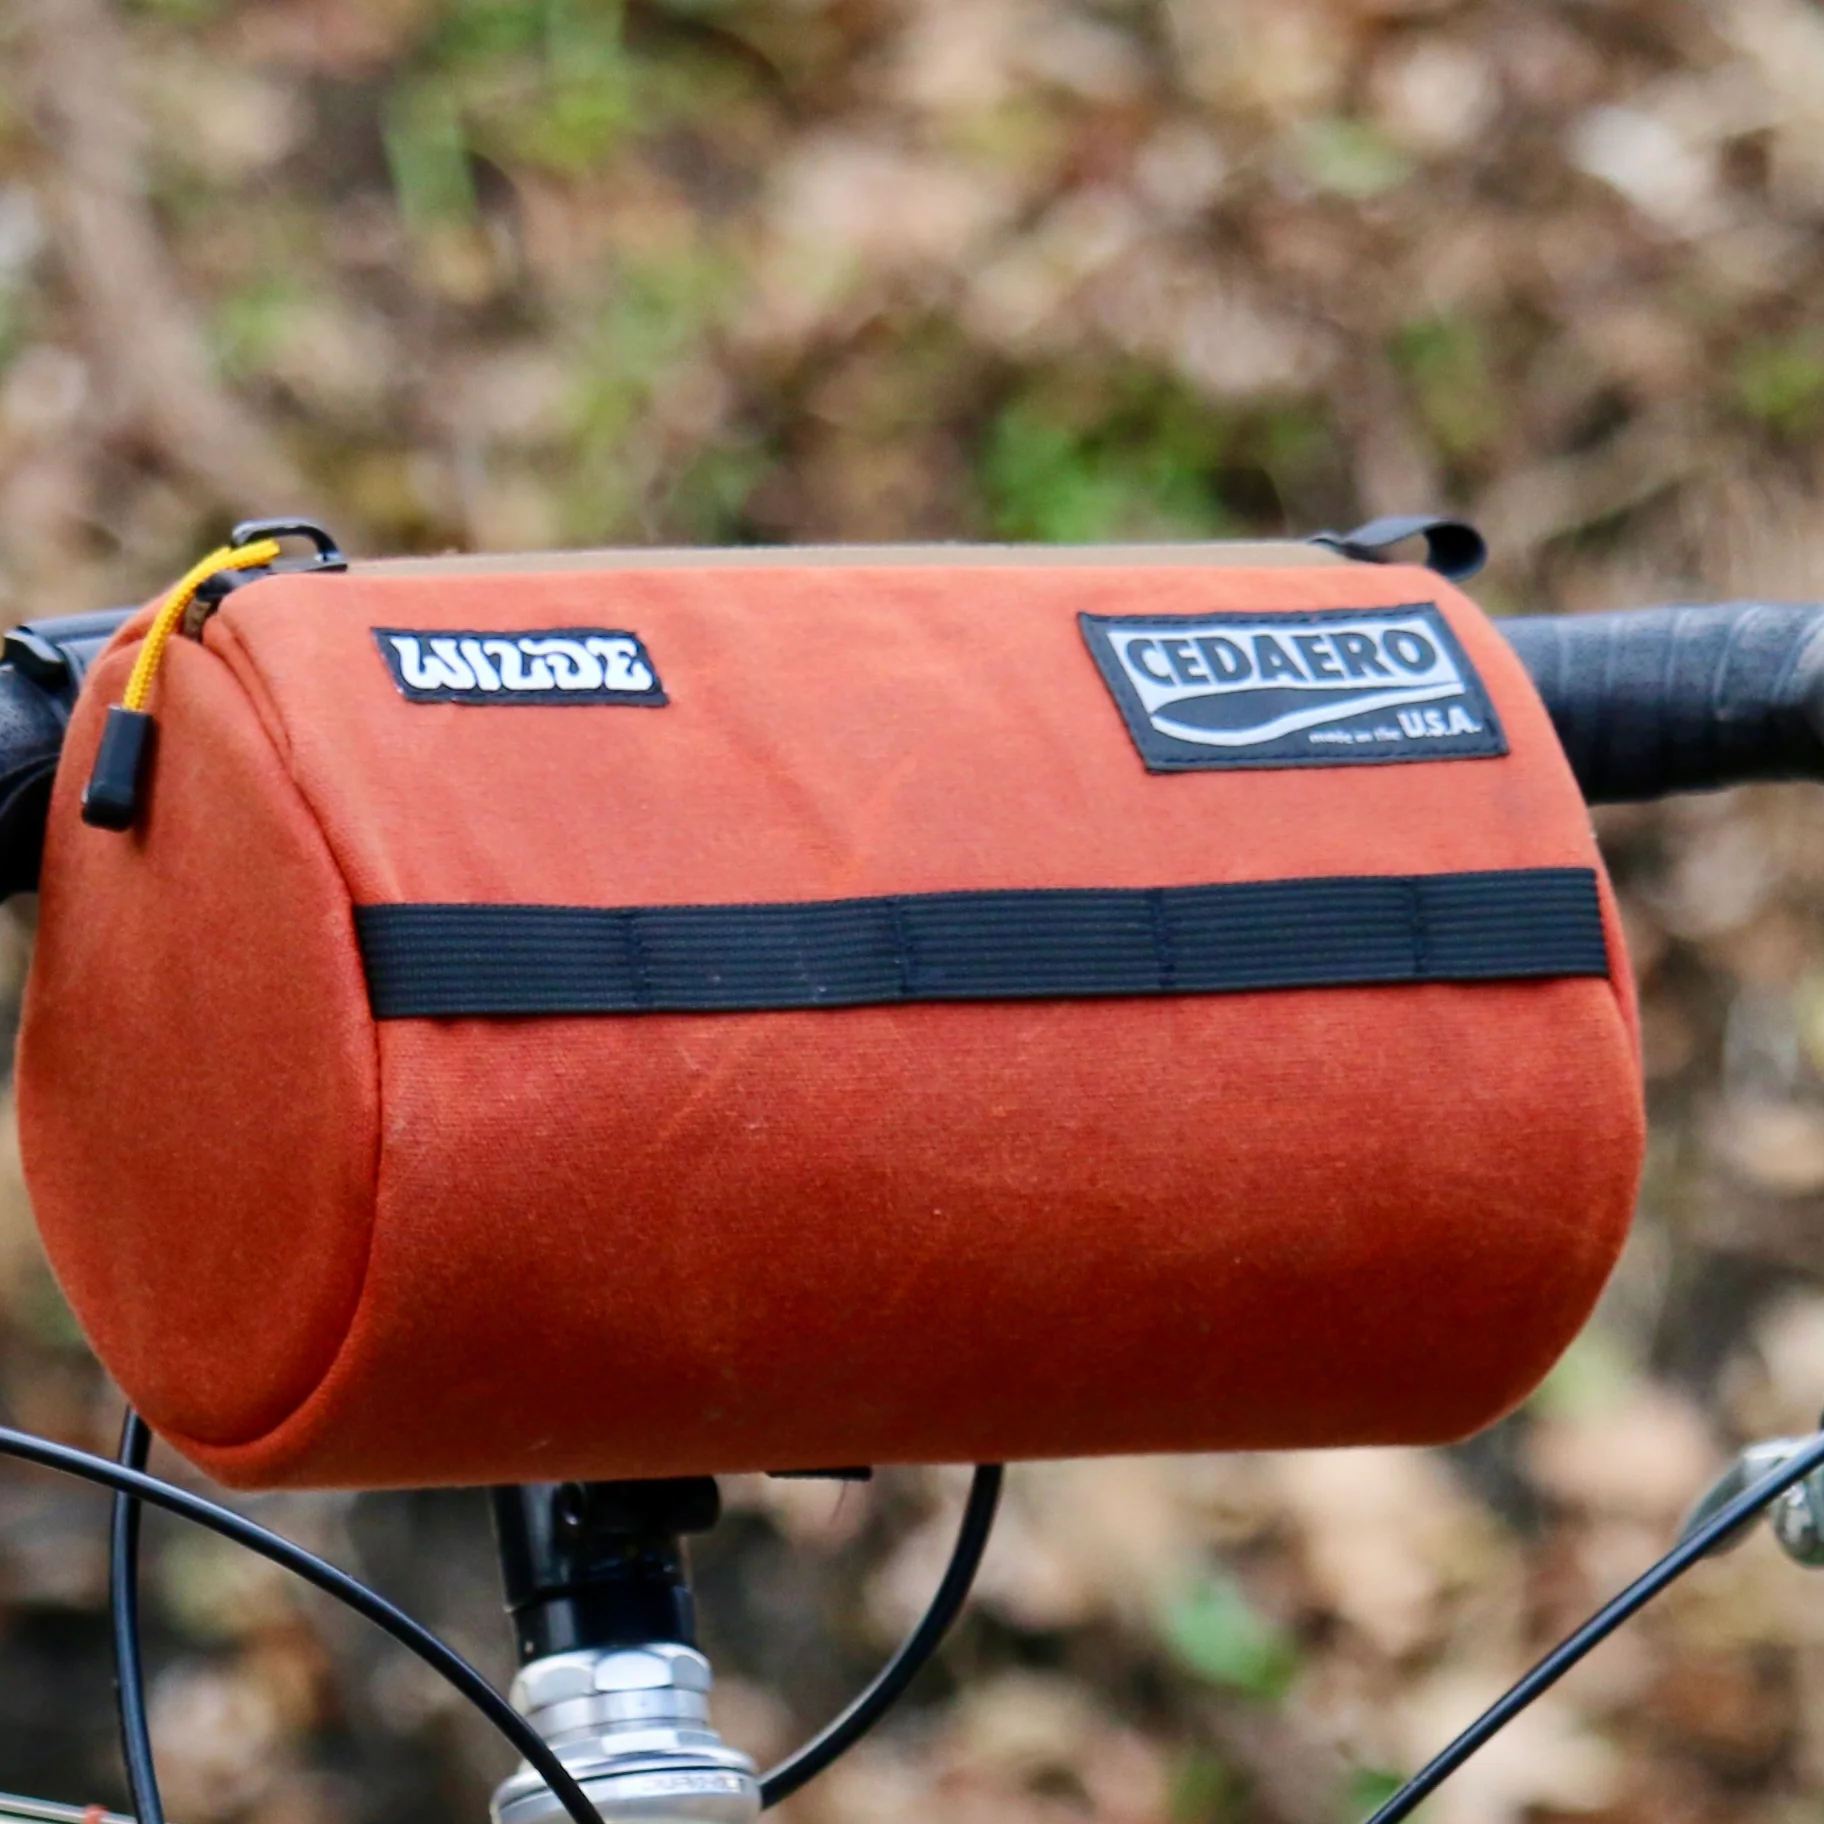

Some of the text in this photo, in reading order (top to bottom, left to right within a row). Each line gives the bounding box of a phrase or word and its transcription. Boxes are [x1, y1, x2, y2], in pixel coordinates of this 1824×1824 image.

[390, 637, 654, 691] WILDE
[1124, 629, 1439, 686] CEDAERO
[1396, 705, 1483, 740] U.S.A.
